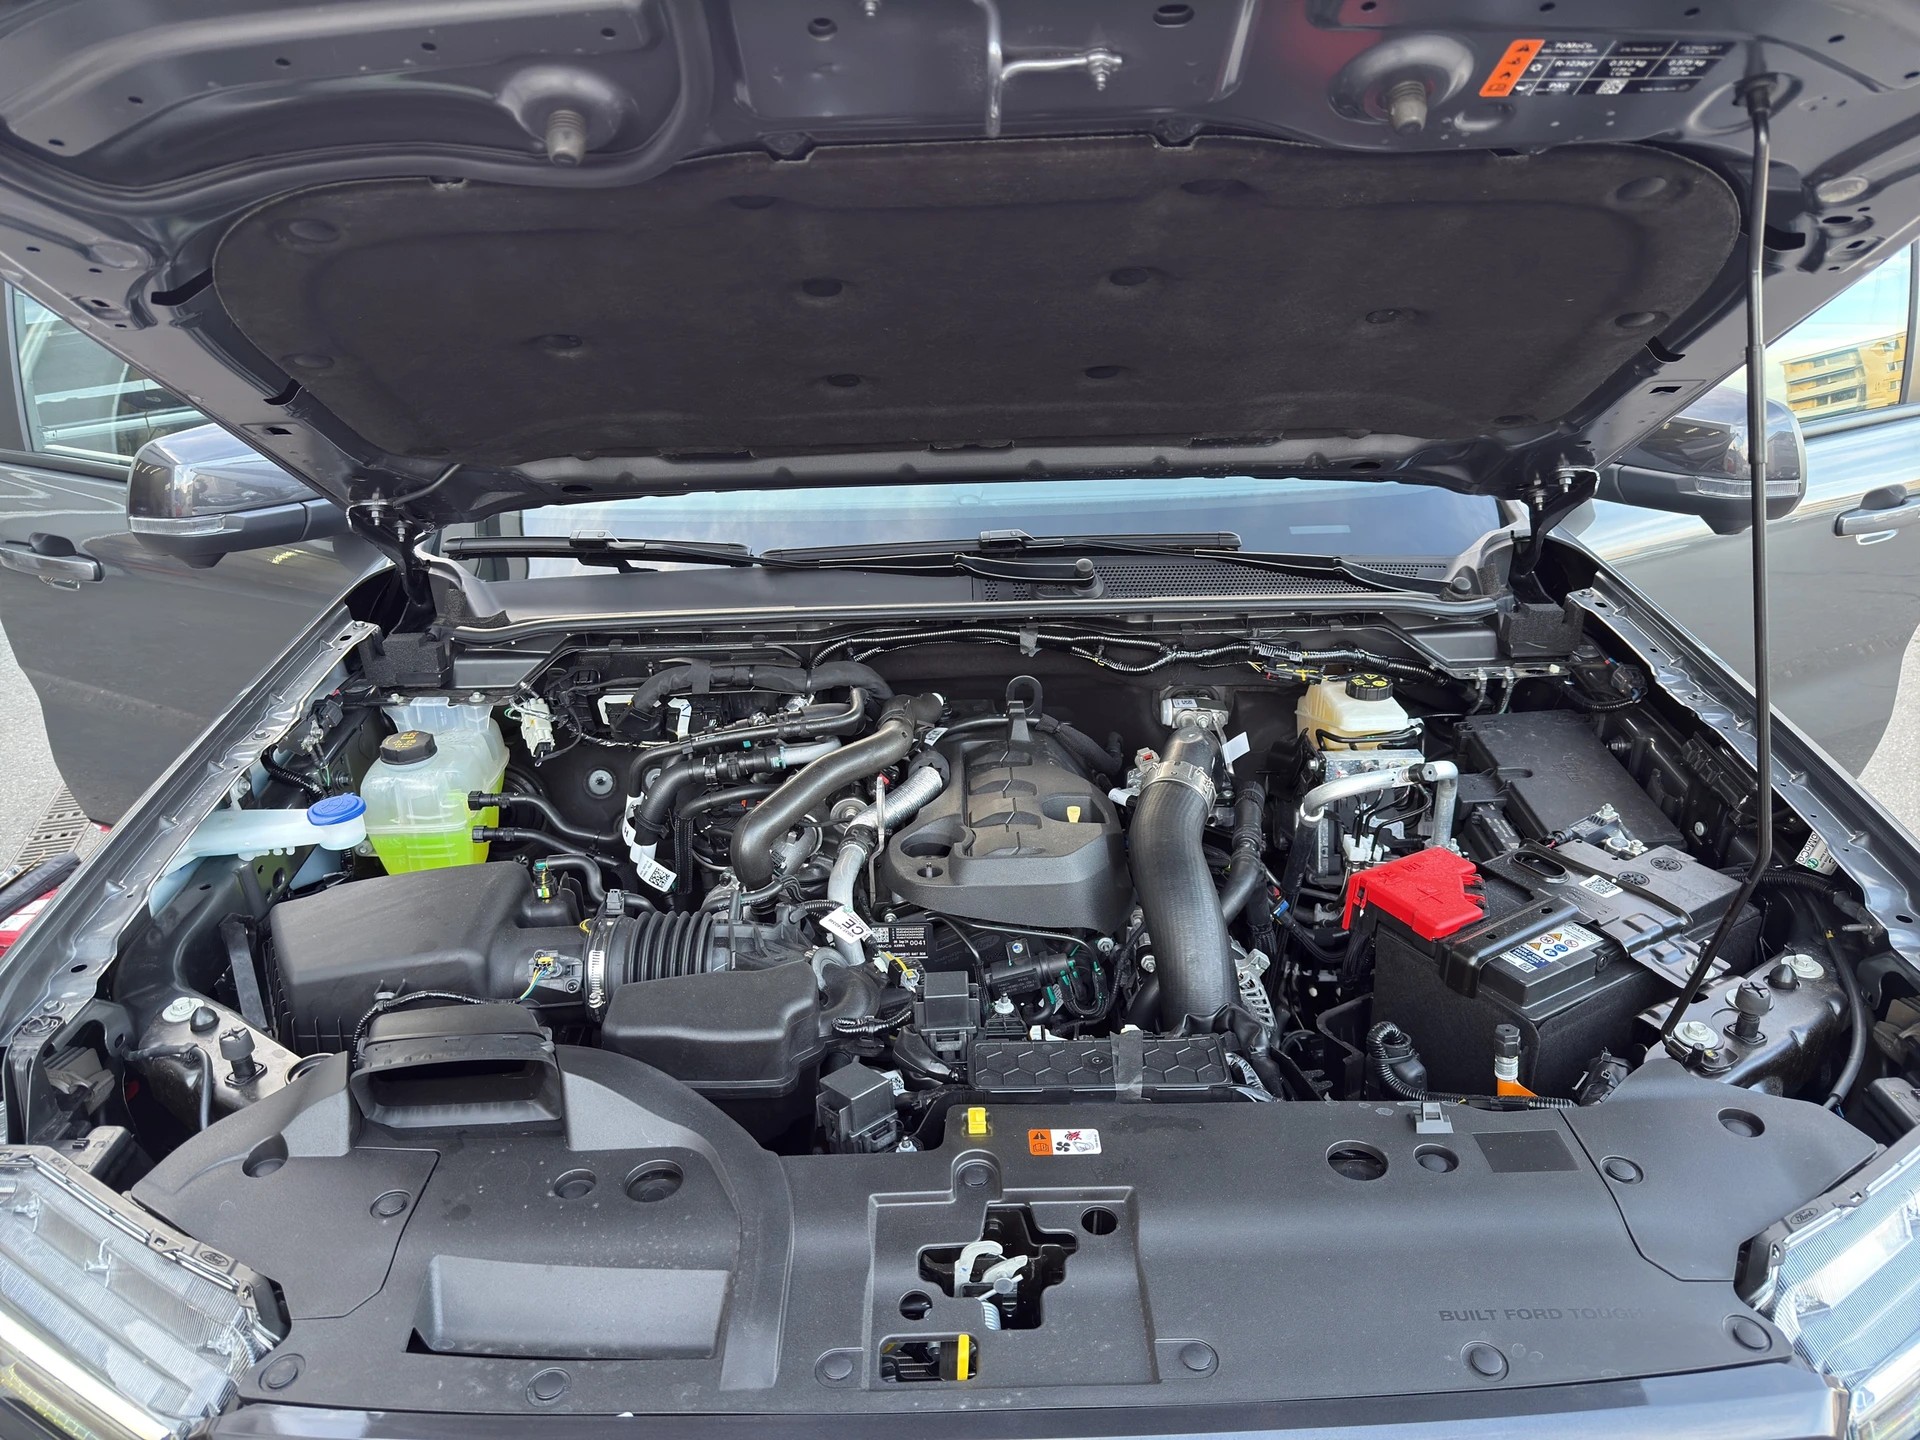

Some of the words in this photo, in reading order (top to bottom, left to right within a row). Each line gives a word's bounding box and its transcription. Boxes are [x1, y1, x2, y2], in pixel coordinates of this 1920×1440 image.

[1798, 833, 1818, 862] oMoCo
[842, 918, 865, 936] CE
[1438, 1309, 1497, 1321] BUILT
[1504, 1308, 1563, 1320] FORD
[1567, 1307, 1644, 1320] TOUGH
